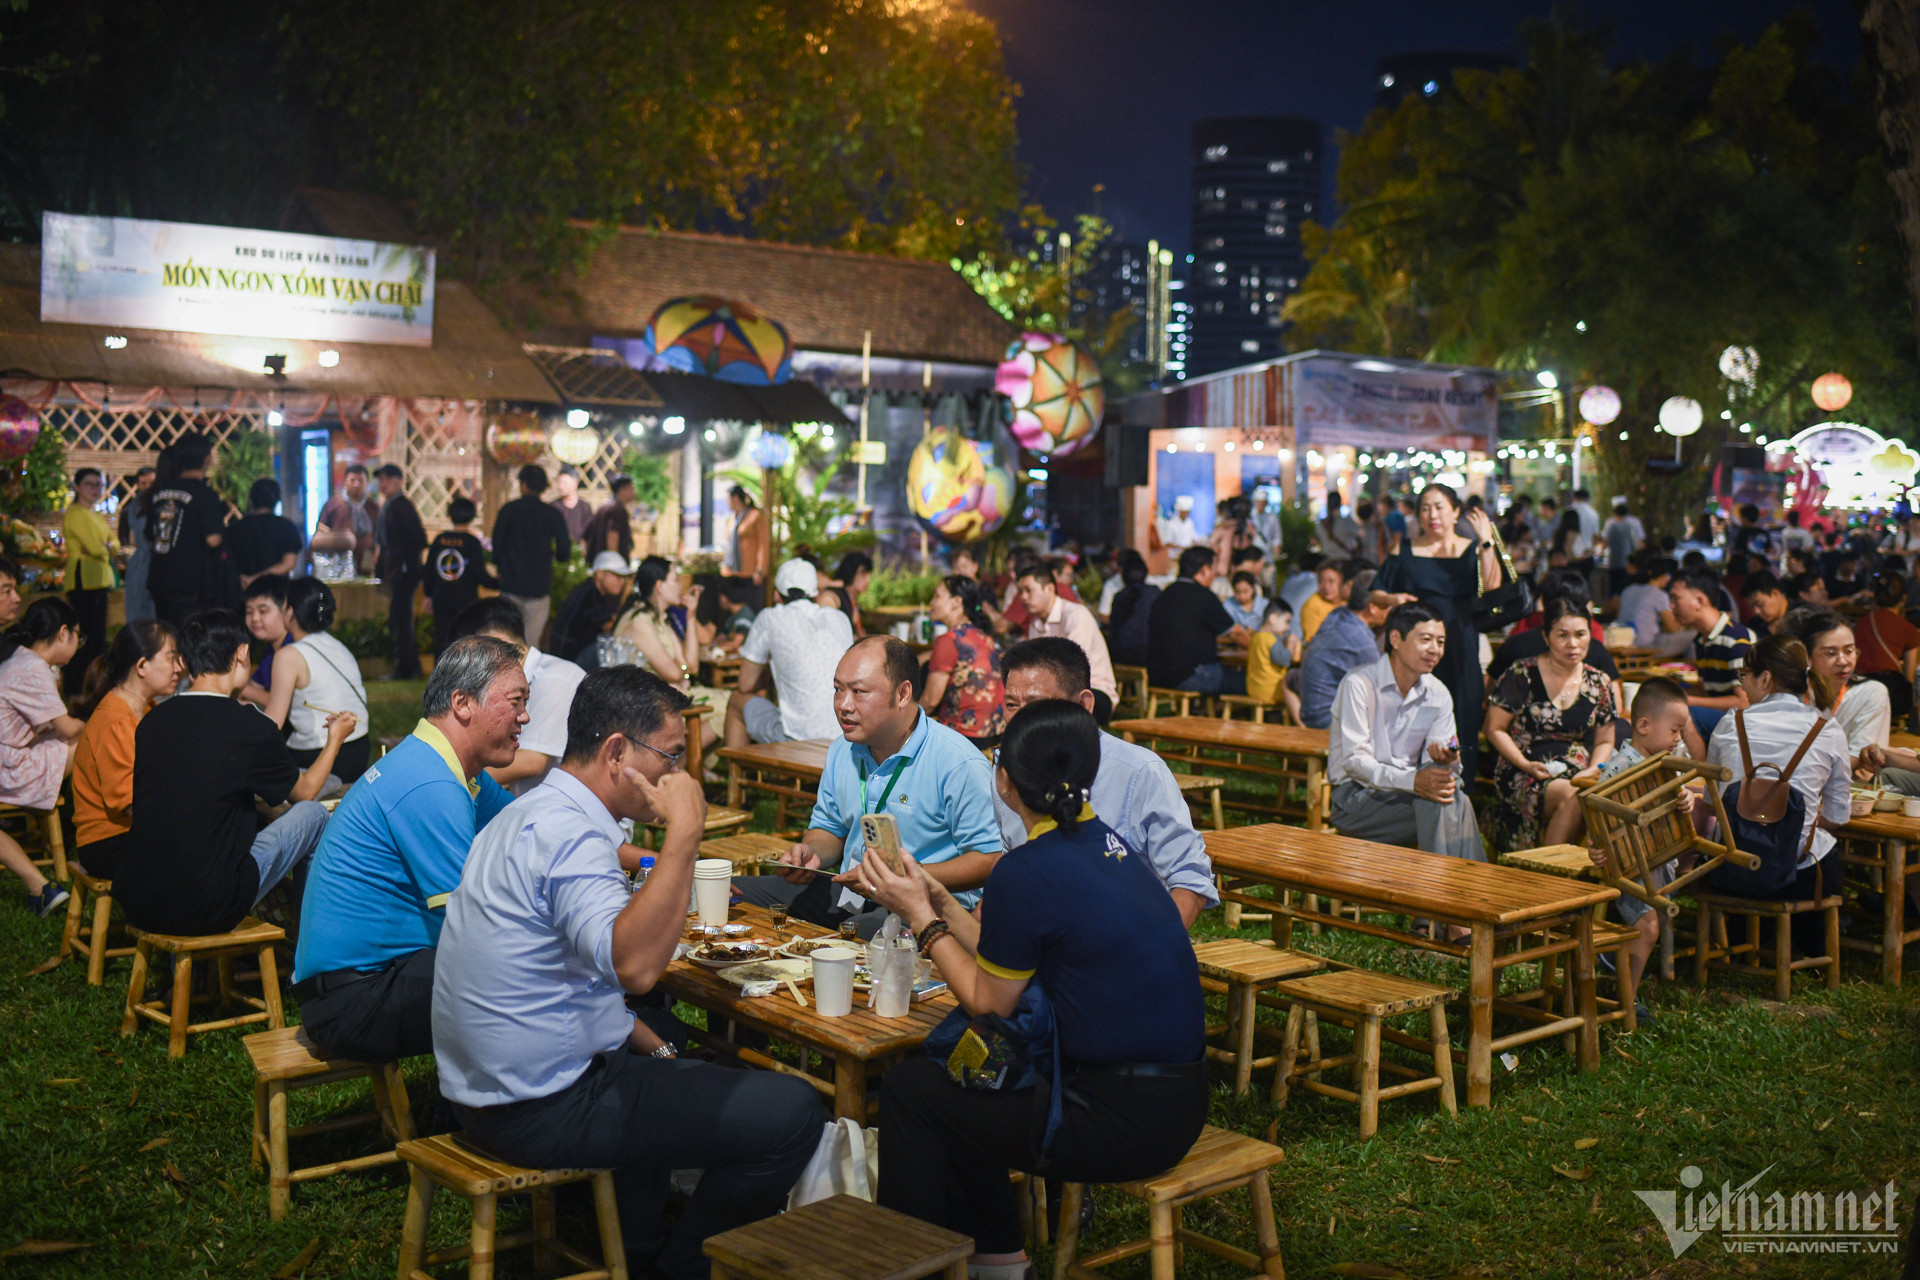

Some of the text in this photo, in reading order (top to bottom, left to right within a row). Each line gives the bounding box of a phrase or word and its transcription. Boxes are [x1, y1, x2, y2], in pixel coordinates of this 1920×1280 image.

[162, 257, 212, 287] MÓN
[216, 268, 275, 292] NGON
[282, 268, 325, 298] XÓM
[332, 277, 371, 305] VẠN
